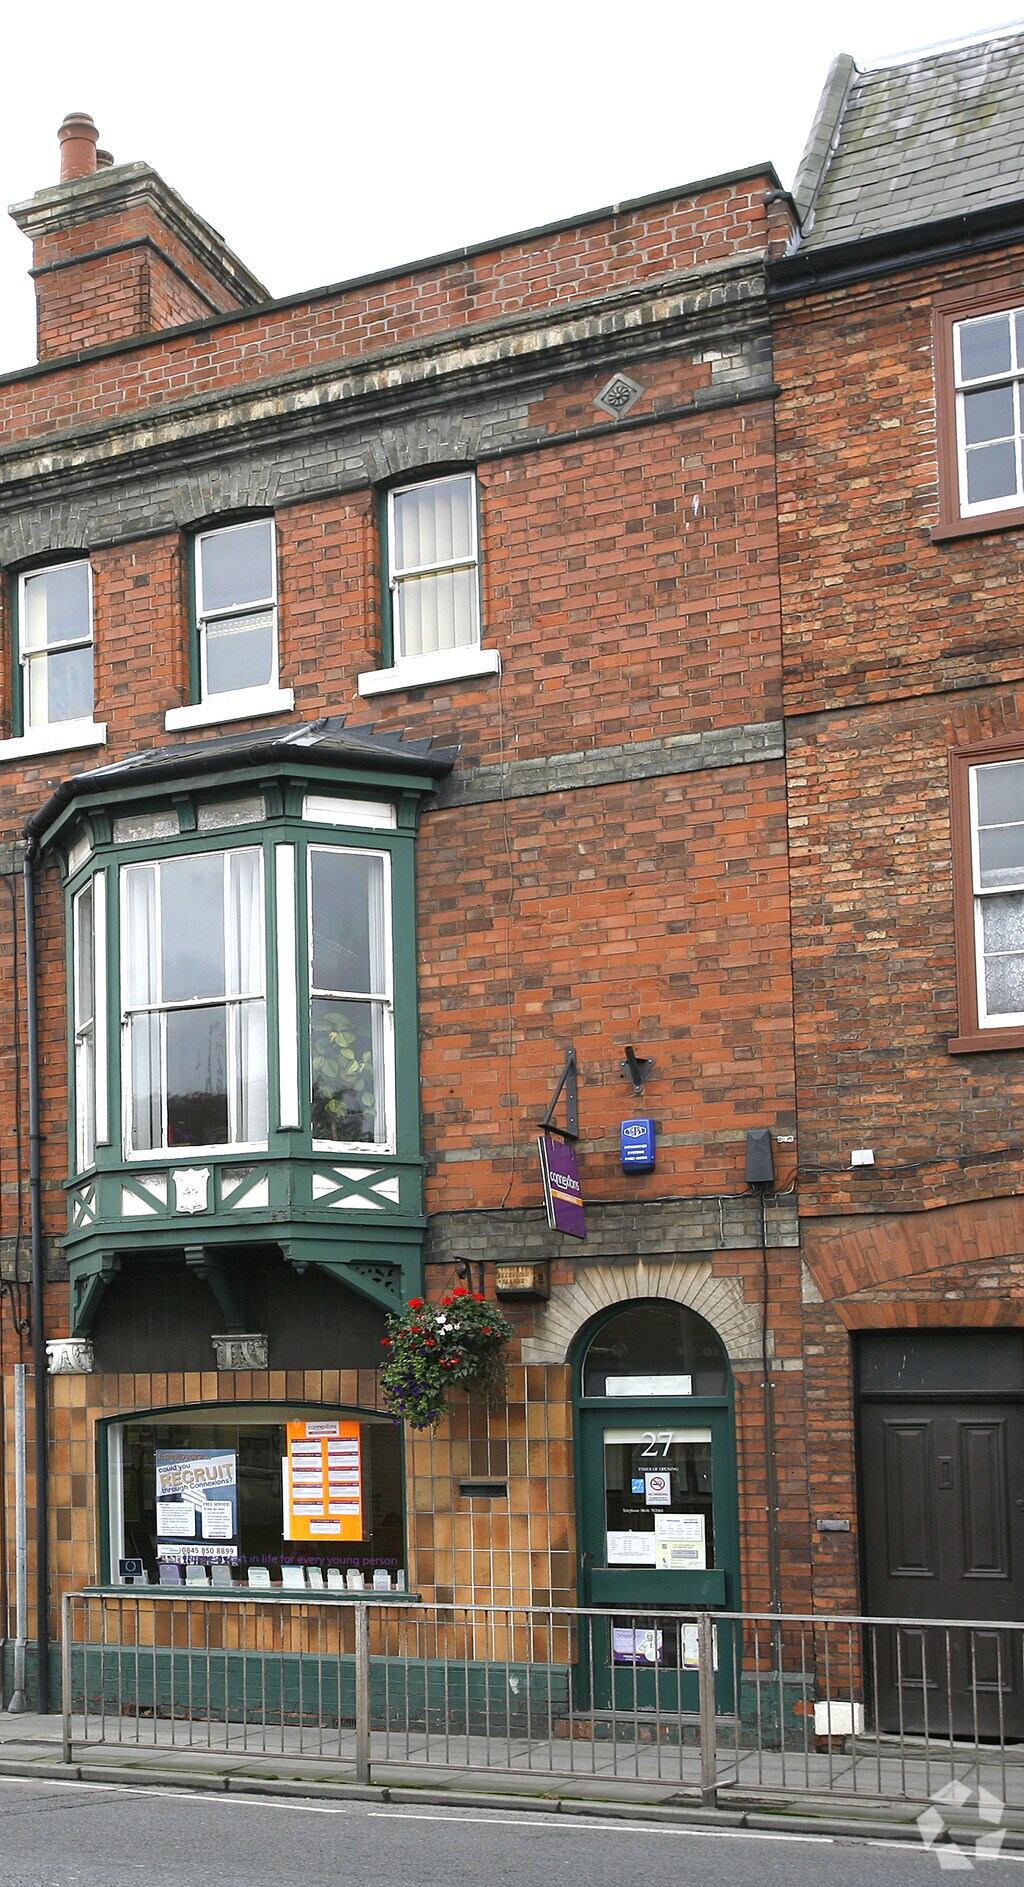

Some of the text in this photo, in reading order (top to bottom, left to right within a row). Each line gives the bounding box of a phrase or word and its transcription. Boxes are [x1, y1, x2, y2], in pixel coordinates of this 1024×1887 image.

[640, 1431, 674, 1457] 27
[158, 1463, 191, 1474] could you
[159, 1463, 234, 1488] RECRUIT
[161, 1476, 233, 1494] through Connexions?
[181, 1546, 199, 1554] 0845
[201, 1547, 214, 1555] 850
[216, 1547, 234, 1555] 8899
[249, 1555, 259, 1564] in
[261, 1554, 277, 1564] life
[280, 1554, 294, 1565] for
[297, 1556, 324, 1567] every
[327, 1557, 359, 1567] young
[362, 1557, 398, 1567] person
